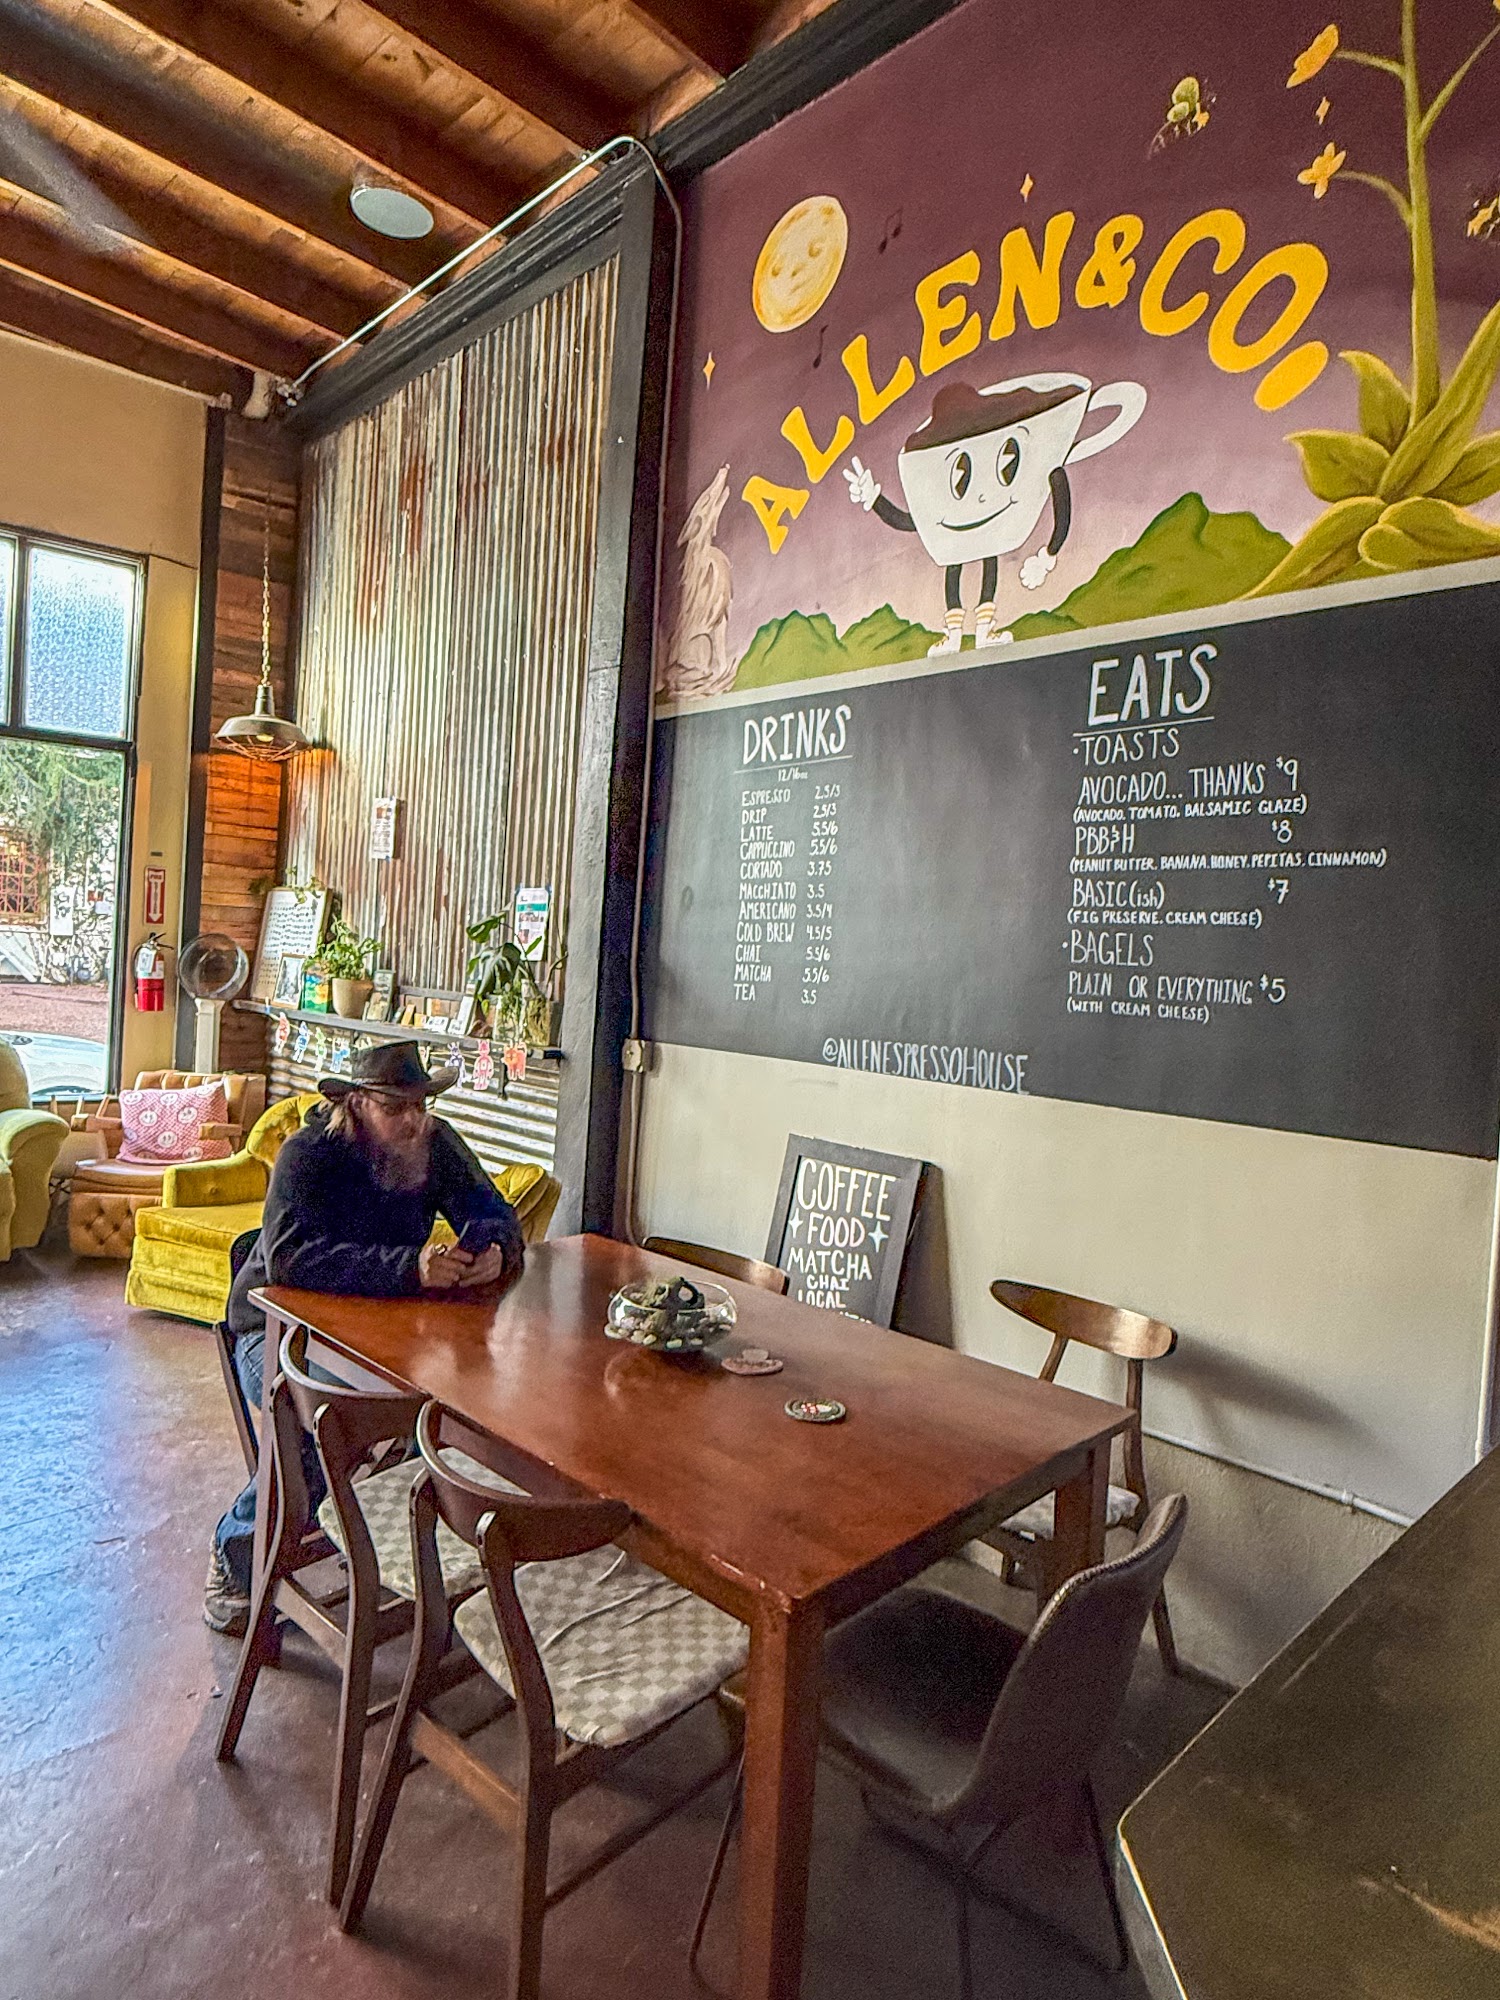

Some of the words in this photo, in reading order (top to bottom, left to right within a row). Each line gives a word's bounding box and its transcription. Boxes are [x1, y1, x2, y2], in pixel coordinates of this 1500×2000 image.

[1087, 643, 1218, 726] EATS
[742, 704, 852, 765] DRINKS
[1080, 728, 1180, 766] TOASTS
[1188, 762, 1266, 799] THANKS
[1276, 756, 1299, 791] $9
[741, 788, 791, 807] ESPRESSO
[814, 783, 841, 800] 2.5/3
[1184, 800, 1252, 818] BALSAMIC
[1257, 794, 1308, 815] GLAZE)
[741, 807, 768, 825] DRIP
[740, 825, 774, 843] LATTE
[811, 820, 839, 837] 5.5/6
[1271, 818, 1293, 844] $8
[739, 840, 796, 861] CAPPUCCINO
[809, 837, 838, 856] 5.5/6
[1069, 856, 1112, 874] (PEANUT
[1307, 848, 1387, 868] CINNAMON)
[740, 860, 783, 880] CORTADO
[807, 860, 832, 876] 3.75
[738, 881, 797, 901] MACCHIATO
[806, 883, 825, 899] 3.5
[1072, 877, 1165, 910] BASIC(ish)
[1267, 878, 1290, 905] $7
[738, 900, 797, 920] AMERICANO
[805, 902, 833, 919] 3.5/4
[1066, 907, 1099, 925] (FIG
[1165, 910, 1207, 925] CREAM
[1210, 908, 1263, 930] CHEESE)
[736, 921, 762, 942] COLD
[766, 922, 795, 943] BREW
[806, 924, 833, 941] 4.5/5
[735, 944, 761, 963] CHAI
[805, 944, 831, 962] 5.5/6
[1070, 929, 1154, 967] BAGELS
[733, 963, 772, 982] MATCHA
[802, 964, 830, 984] 5.5/6
[733, 983, 756, 1001] TEA
[801, 989, 817, 1005] 3.5
[1068, 970, 1112, 996] PLAIN
[1128, 975, 1149, 998] OR
[1156, 975, 1253, 1005] EVERYTHING
[1259, 974, 1287, 1003] $5
[1066, 997, 1103, 1014] (WITH
[1111, 1000, 1150, 1017] CREAM
[1157, 1004, 1210, 1025] CHEESE)
[797, 1158, 896, 1222] COFFEE
[807, 1211, 866, 1248] FOOD
[786, 1246, 873, 1281] MATCHA
[806, 1274, 850, 1291] CHAI
